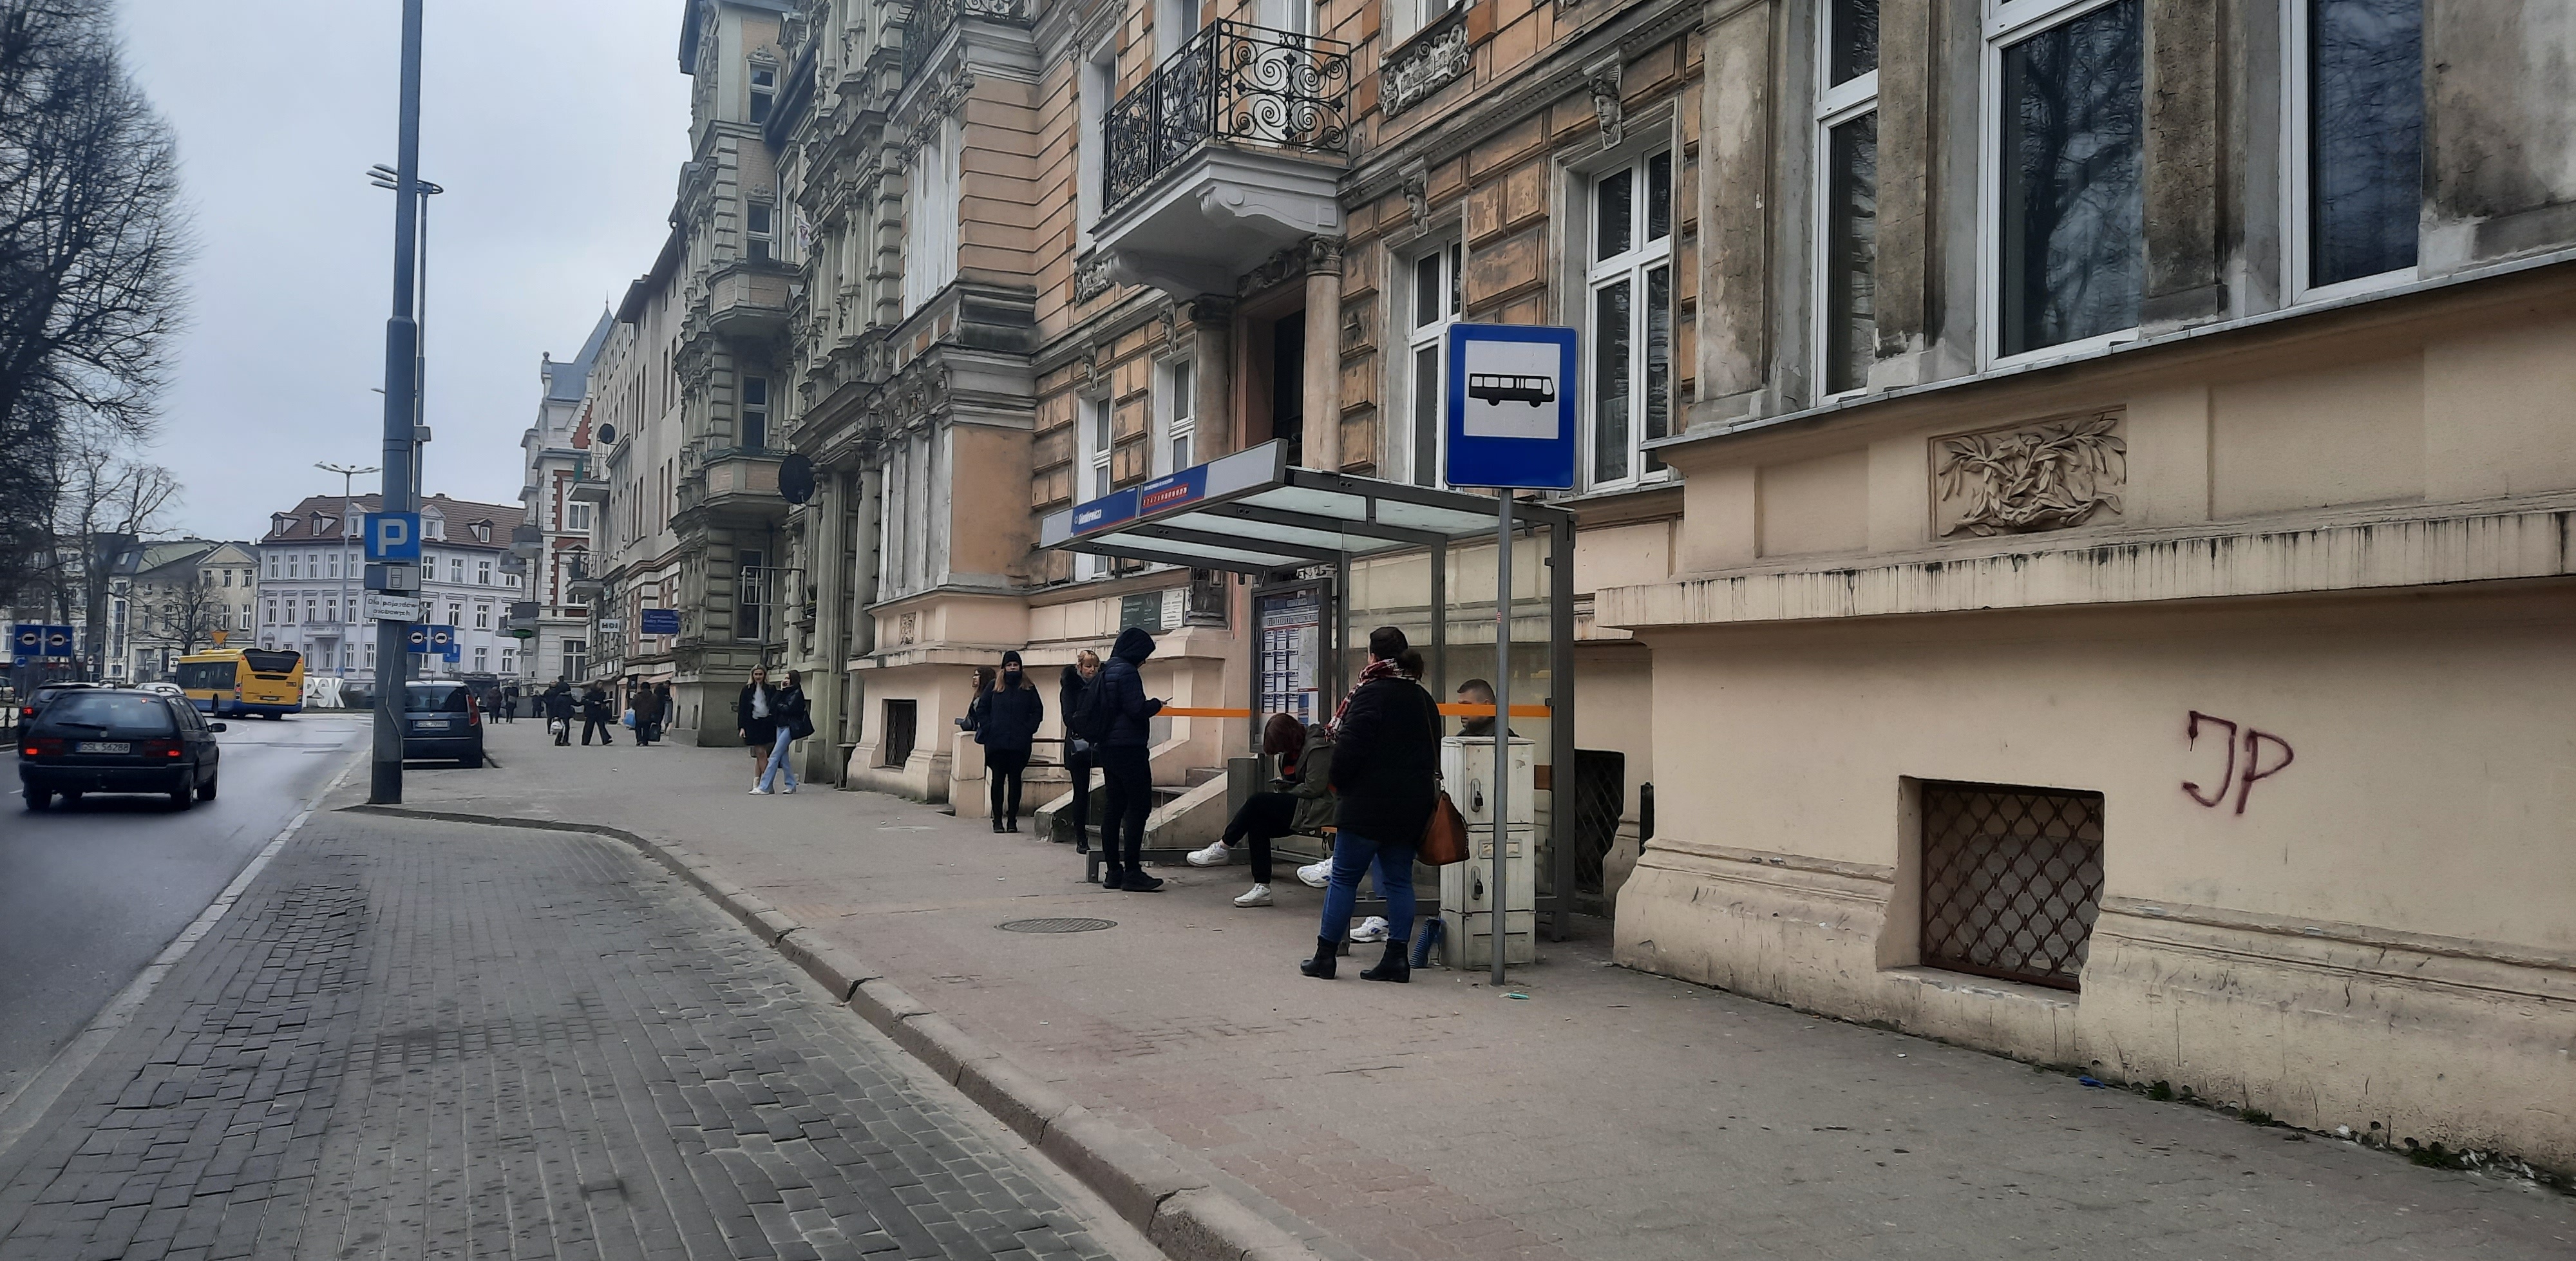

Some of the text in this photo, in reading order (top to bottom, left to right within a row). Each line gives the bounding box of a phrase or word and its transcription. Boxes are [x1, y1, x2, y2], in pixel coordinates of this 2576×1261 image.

[377, 518, 408, 556] P
[81, 743, 97, 752] GSL
[2182, 710, 2294, 814] JP
